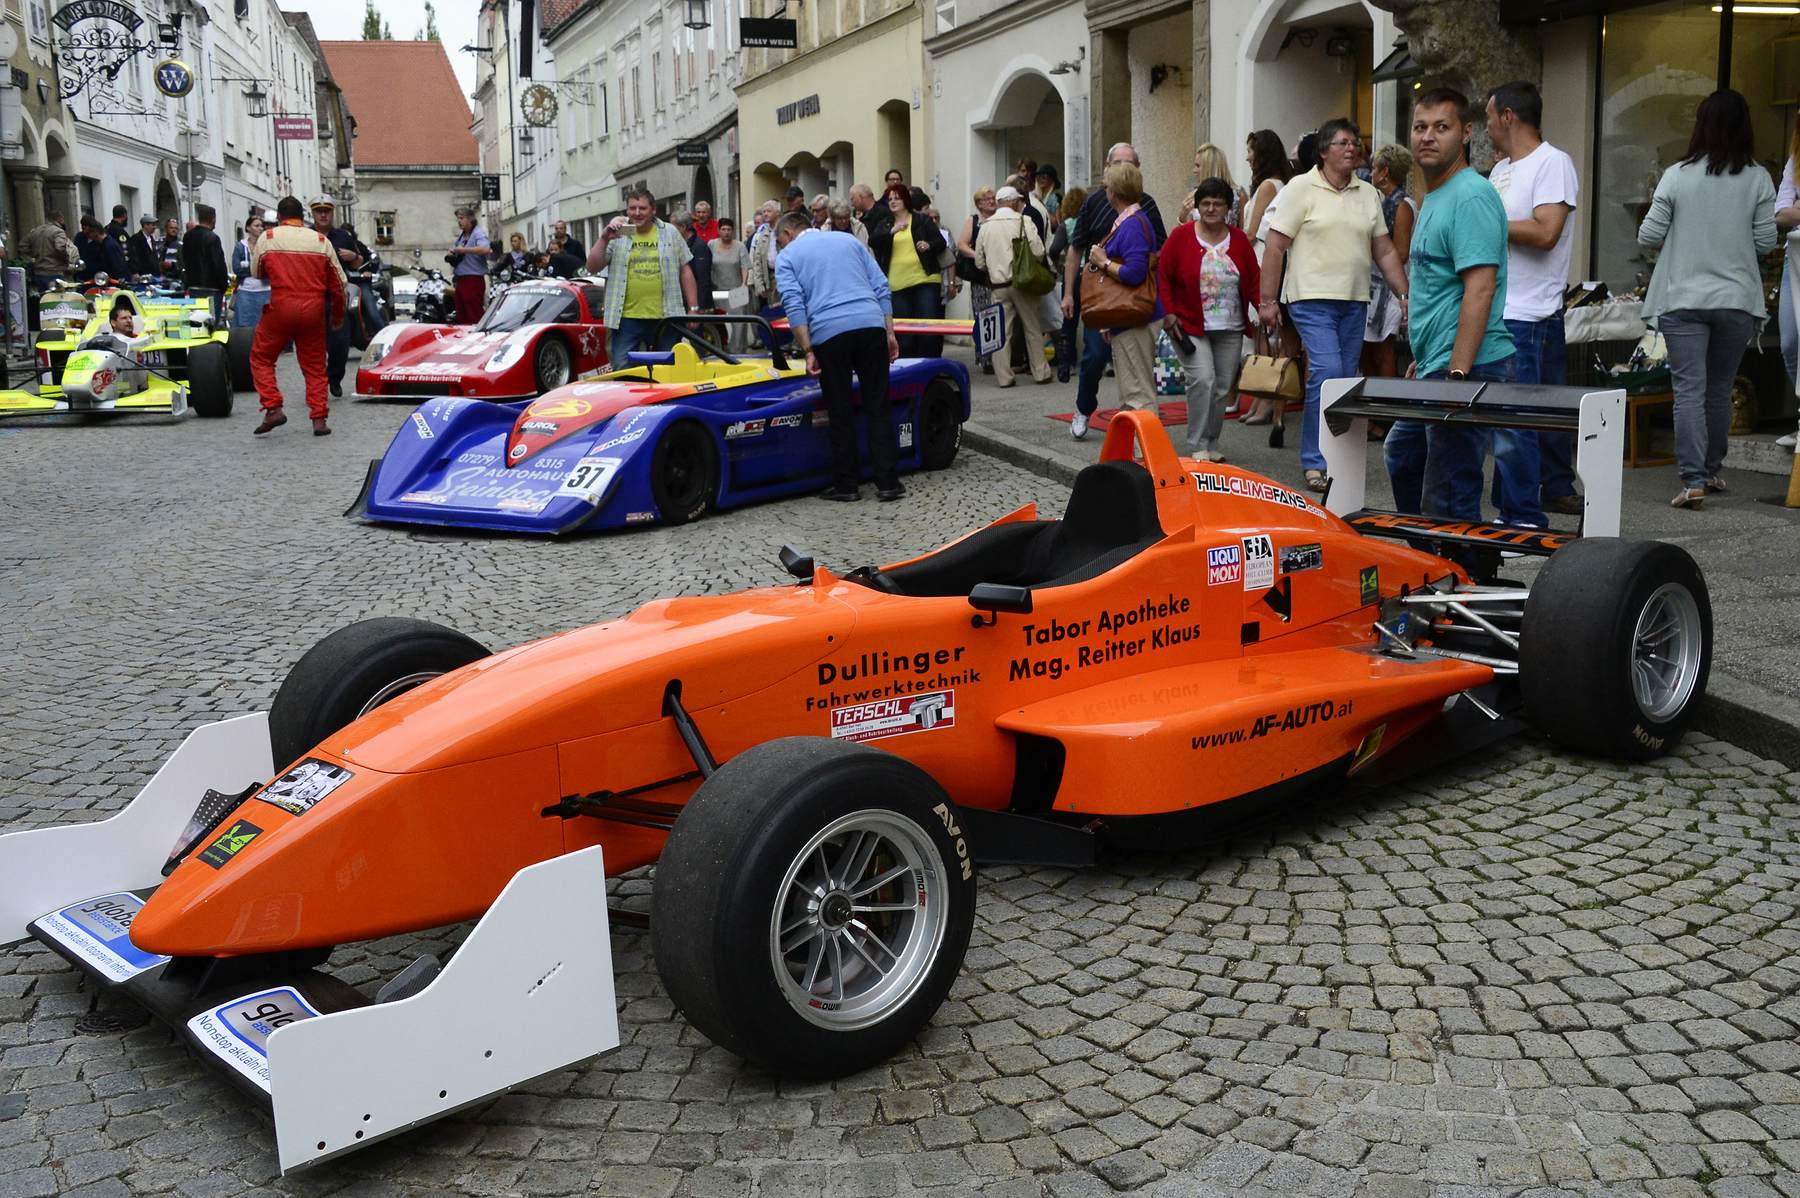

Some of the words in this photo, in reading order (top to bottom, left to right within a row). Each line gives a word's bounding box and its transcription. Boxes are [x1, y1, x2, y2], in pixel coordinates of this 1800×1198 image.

[743, 38, 768, 46] TALLY
[983, 315, 996, 343] 37
[458, 453, 501, 467] 07279/
[534, 458, 566, 470] 8315
[567, 466, 606, 489] 37
[1209, 549, 1239, 566] LIQUI
[1210, 565, 1240, 583] MOLY
[1023, 619, 1091, 646] Tabor
[1097, 594, 1191, 635] Apotheke
[818, 646, 966, 686] Dullinger
[1009, 656, 1071, 682] Mag.
[1078, 639, 1146, 668] Reitter
[1152, 623, 1201, 650] Klaus
[806, 668, 982, 712] Fahrwerktechnik
[836, 700, 903, 725] TERSCHL
[932, 802, 973, 882] AVON
[81, 901, 136, 930] globa
[197, 1015, 233, 1050] Nonstop
